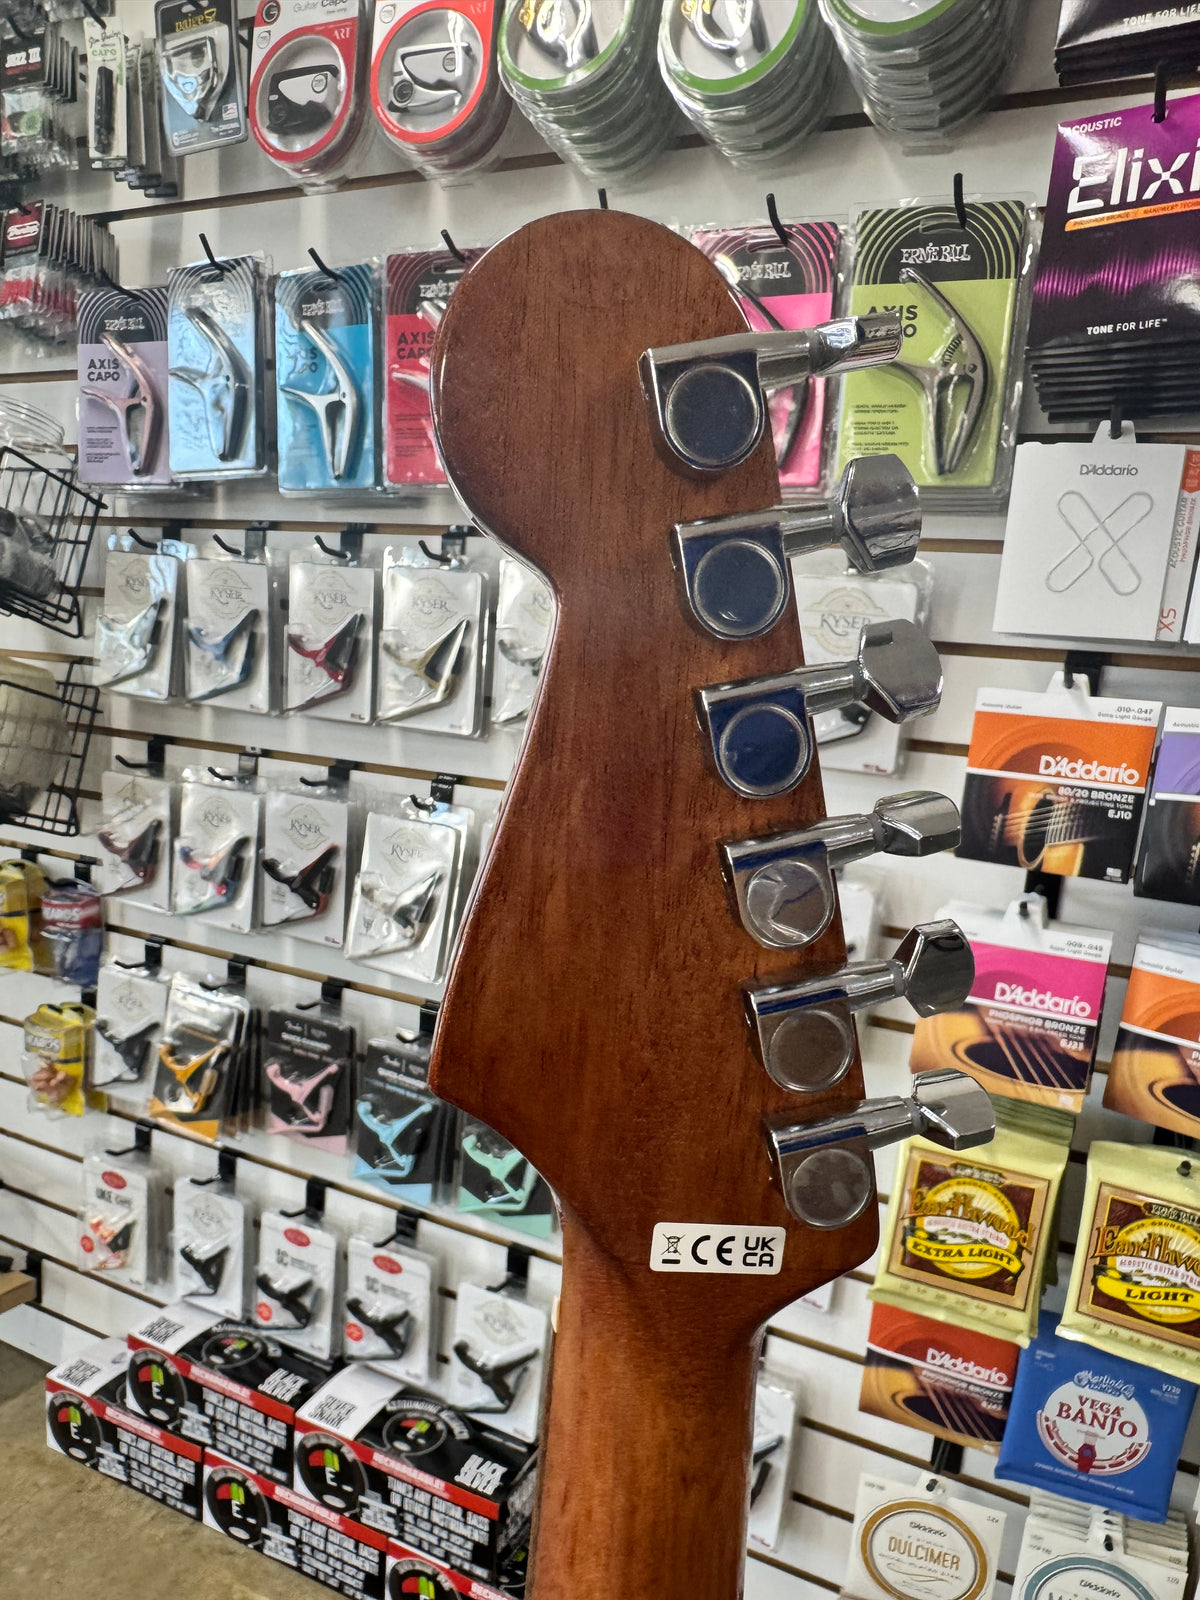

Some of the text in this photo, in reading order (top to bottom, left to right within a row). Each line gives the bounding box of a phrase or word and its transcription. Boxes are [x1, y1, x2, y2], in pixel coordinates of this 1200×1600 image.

[1123, 13, 1151, 27] TONE
[1156, 8, 1176, 19] FOR
[92, 48, 117, 57] CAPO
[901, 243, 971, 264] ERNIE BALL
[737, 260, 791, 280] RNIE BALL
[1087, 325, 1113, 335] TONE
[1116, 323, 1135, 332] FOR
[88, 358, 119, 370] AXIS
[87, 371, 120, 382] CAPO
[1079, 464, 1138, 476] D'Addario
[412, 596, 447, 615] KYSER
[1159, 607, 1177, 633] XS
[1039, 755, 1140, 785] D'Addario
[1058, 786, 1089, 799] 80/20
[1090, 790, 1135, 804] BRONZE
[1108, 809, 1132, 820] EJ10
[290, 819, 321, 838] KYSER
[994, 982, 1091, 1017] D'Addario
[1044, 1018, 1087, 1036] BRONZE
[903, 1186, 1036, 1255] Earthwood
[692, 1235, 736, 1266] CE
[744, 1236, 777, 1251] UK
[742, 1252, 774, 1267] CA
[911, 1240, 1016, 1267] EXTRA LIGHT
[1153, 1264, 1180, 1278] GUITAR
[1125, 1288, 1194, 1304] LIGHT
[926, 1347, 1008, 1385] D'Addario
[1056, 1401, 1138, 1438] BANJO
[888, 1536, 961, 1572] DULCIMER
